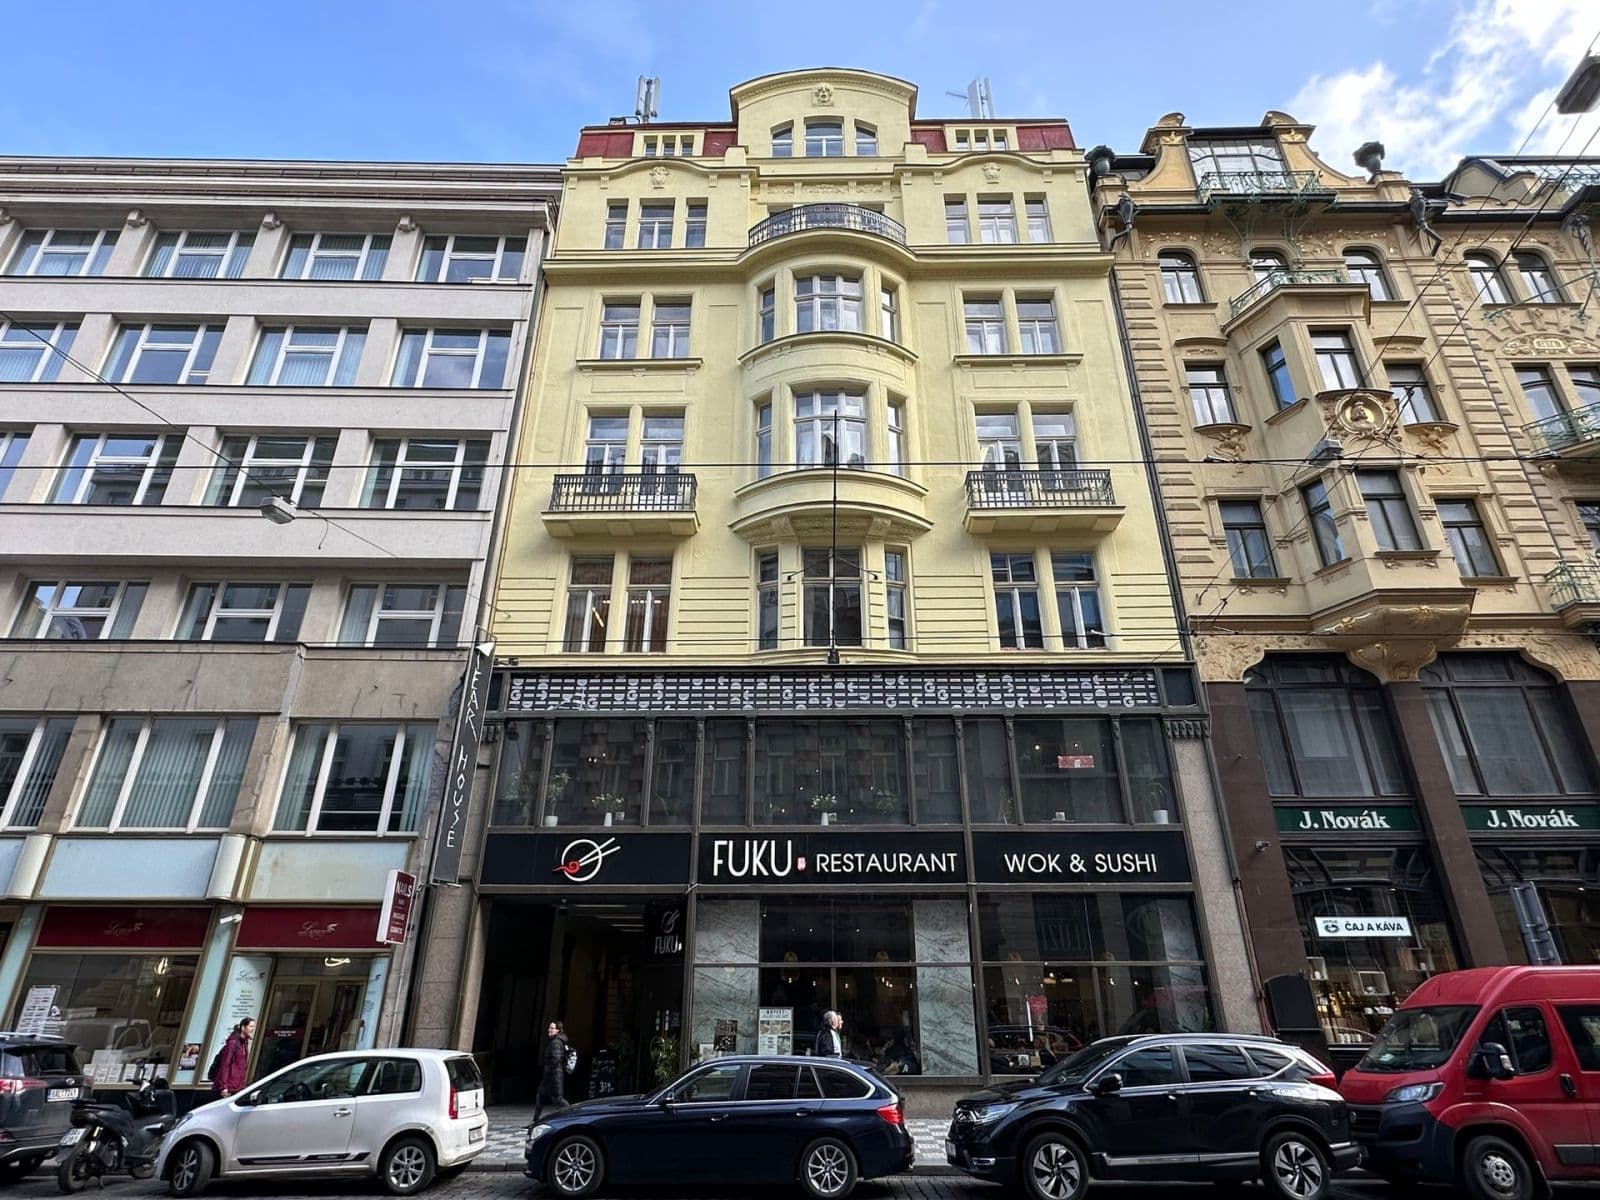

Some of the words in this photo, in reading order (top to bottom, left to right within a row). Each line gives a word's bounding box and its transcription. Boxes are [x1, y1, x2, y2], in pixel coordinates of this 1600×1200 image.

[446, 744, 468, 848] HOUSE
[1299, 811, 1319, 829] J.
[1320, 810, 1391, 829] Novák
[1487, 810, 1507, 828] J.
[1507, 809, 1579, 828] Novák
[713, 840, 792, 877] FUKU
[816, 853, 958, 873] RESTAURANT
[1004, 853, 1063, 873] WOK
[1069, 853, 1087, 873] &
[1094, 853, 1157, 873] SUSHI
[1344, 920, 1364, 932] ČAJ
[1366, 922, 1375, 932] A
[1375, 920, 1404, 932] KÁVA
[655, 935, 678, 954] FUKU
